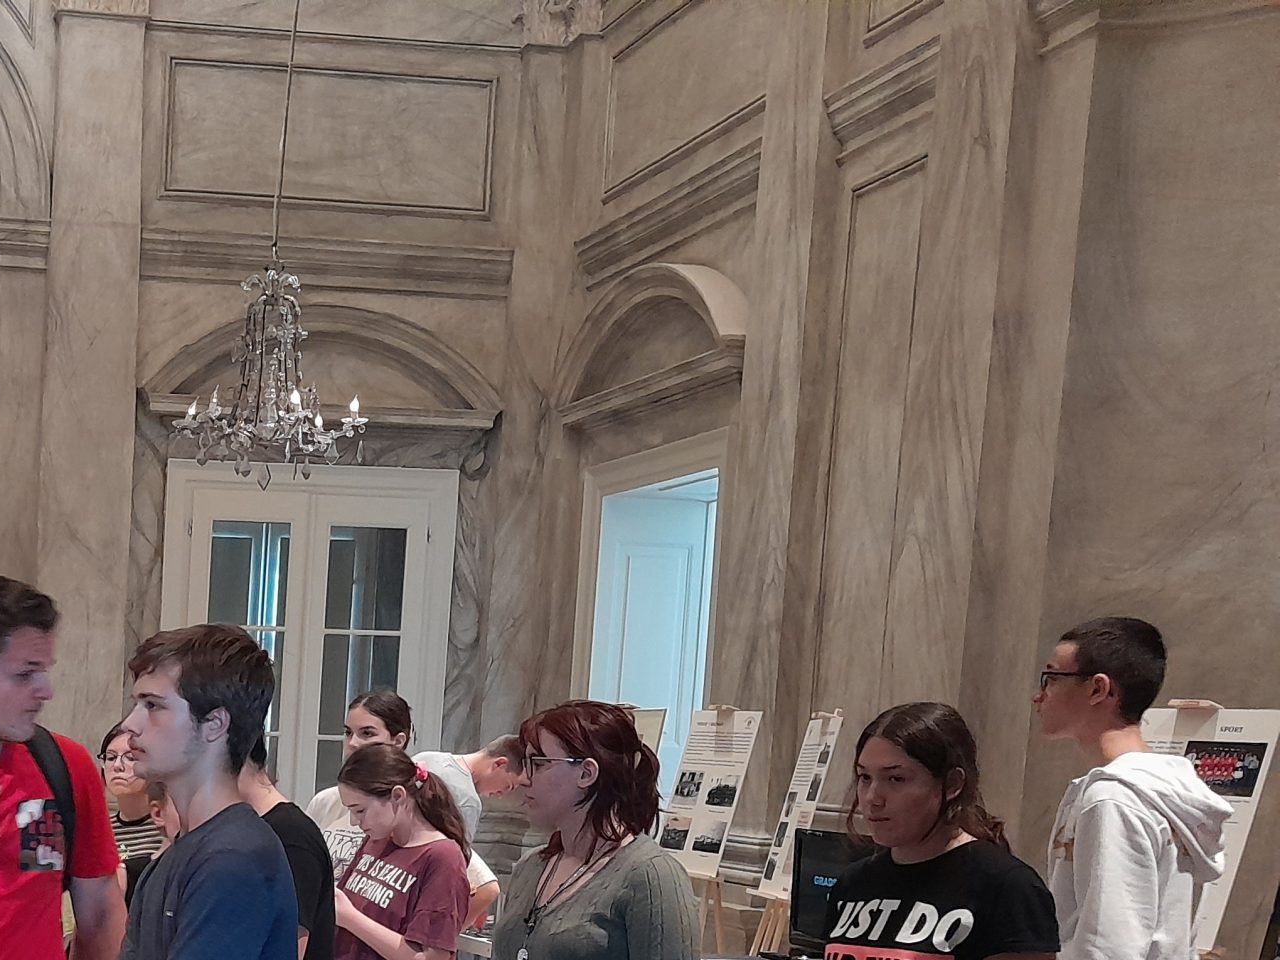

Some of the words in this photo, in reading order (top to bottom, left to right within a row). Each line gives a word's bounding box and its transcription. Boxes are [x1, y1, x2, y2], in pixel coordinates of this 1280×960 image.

[368, 858, 384, 877] IS
[829, 899, 902, 941] UST
[895, 901, 975, 953] DO
